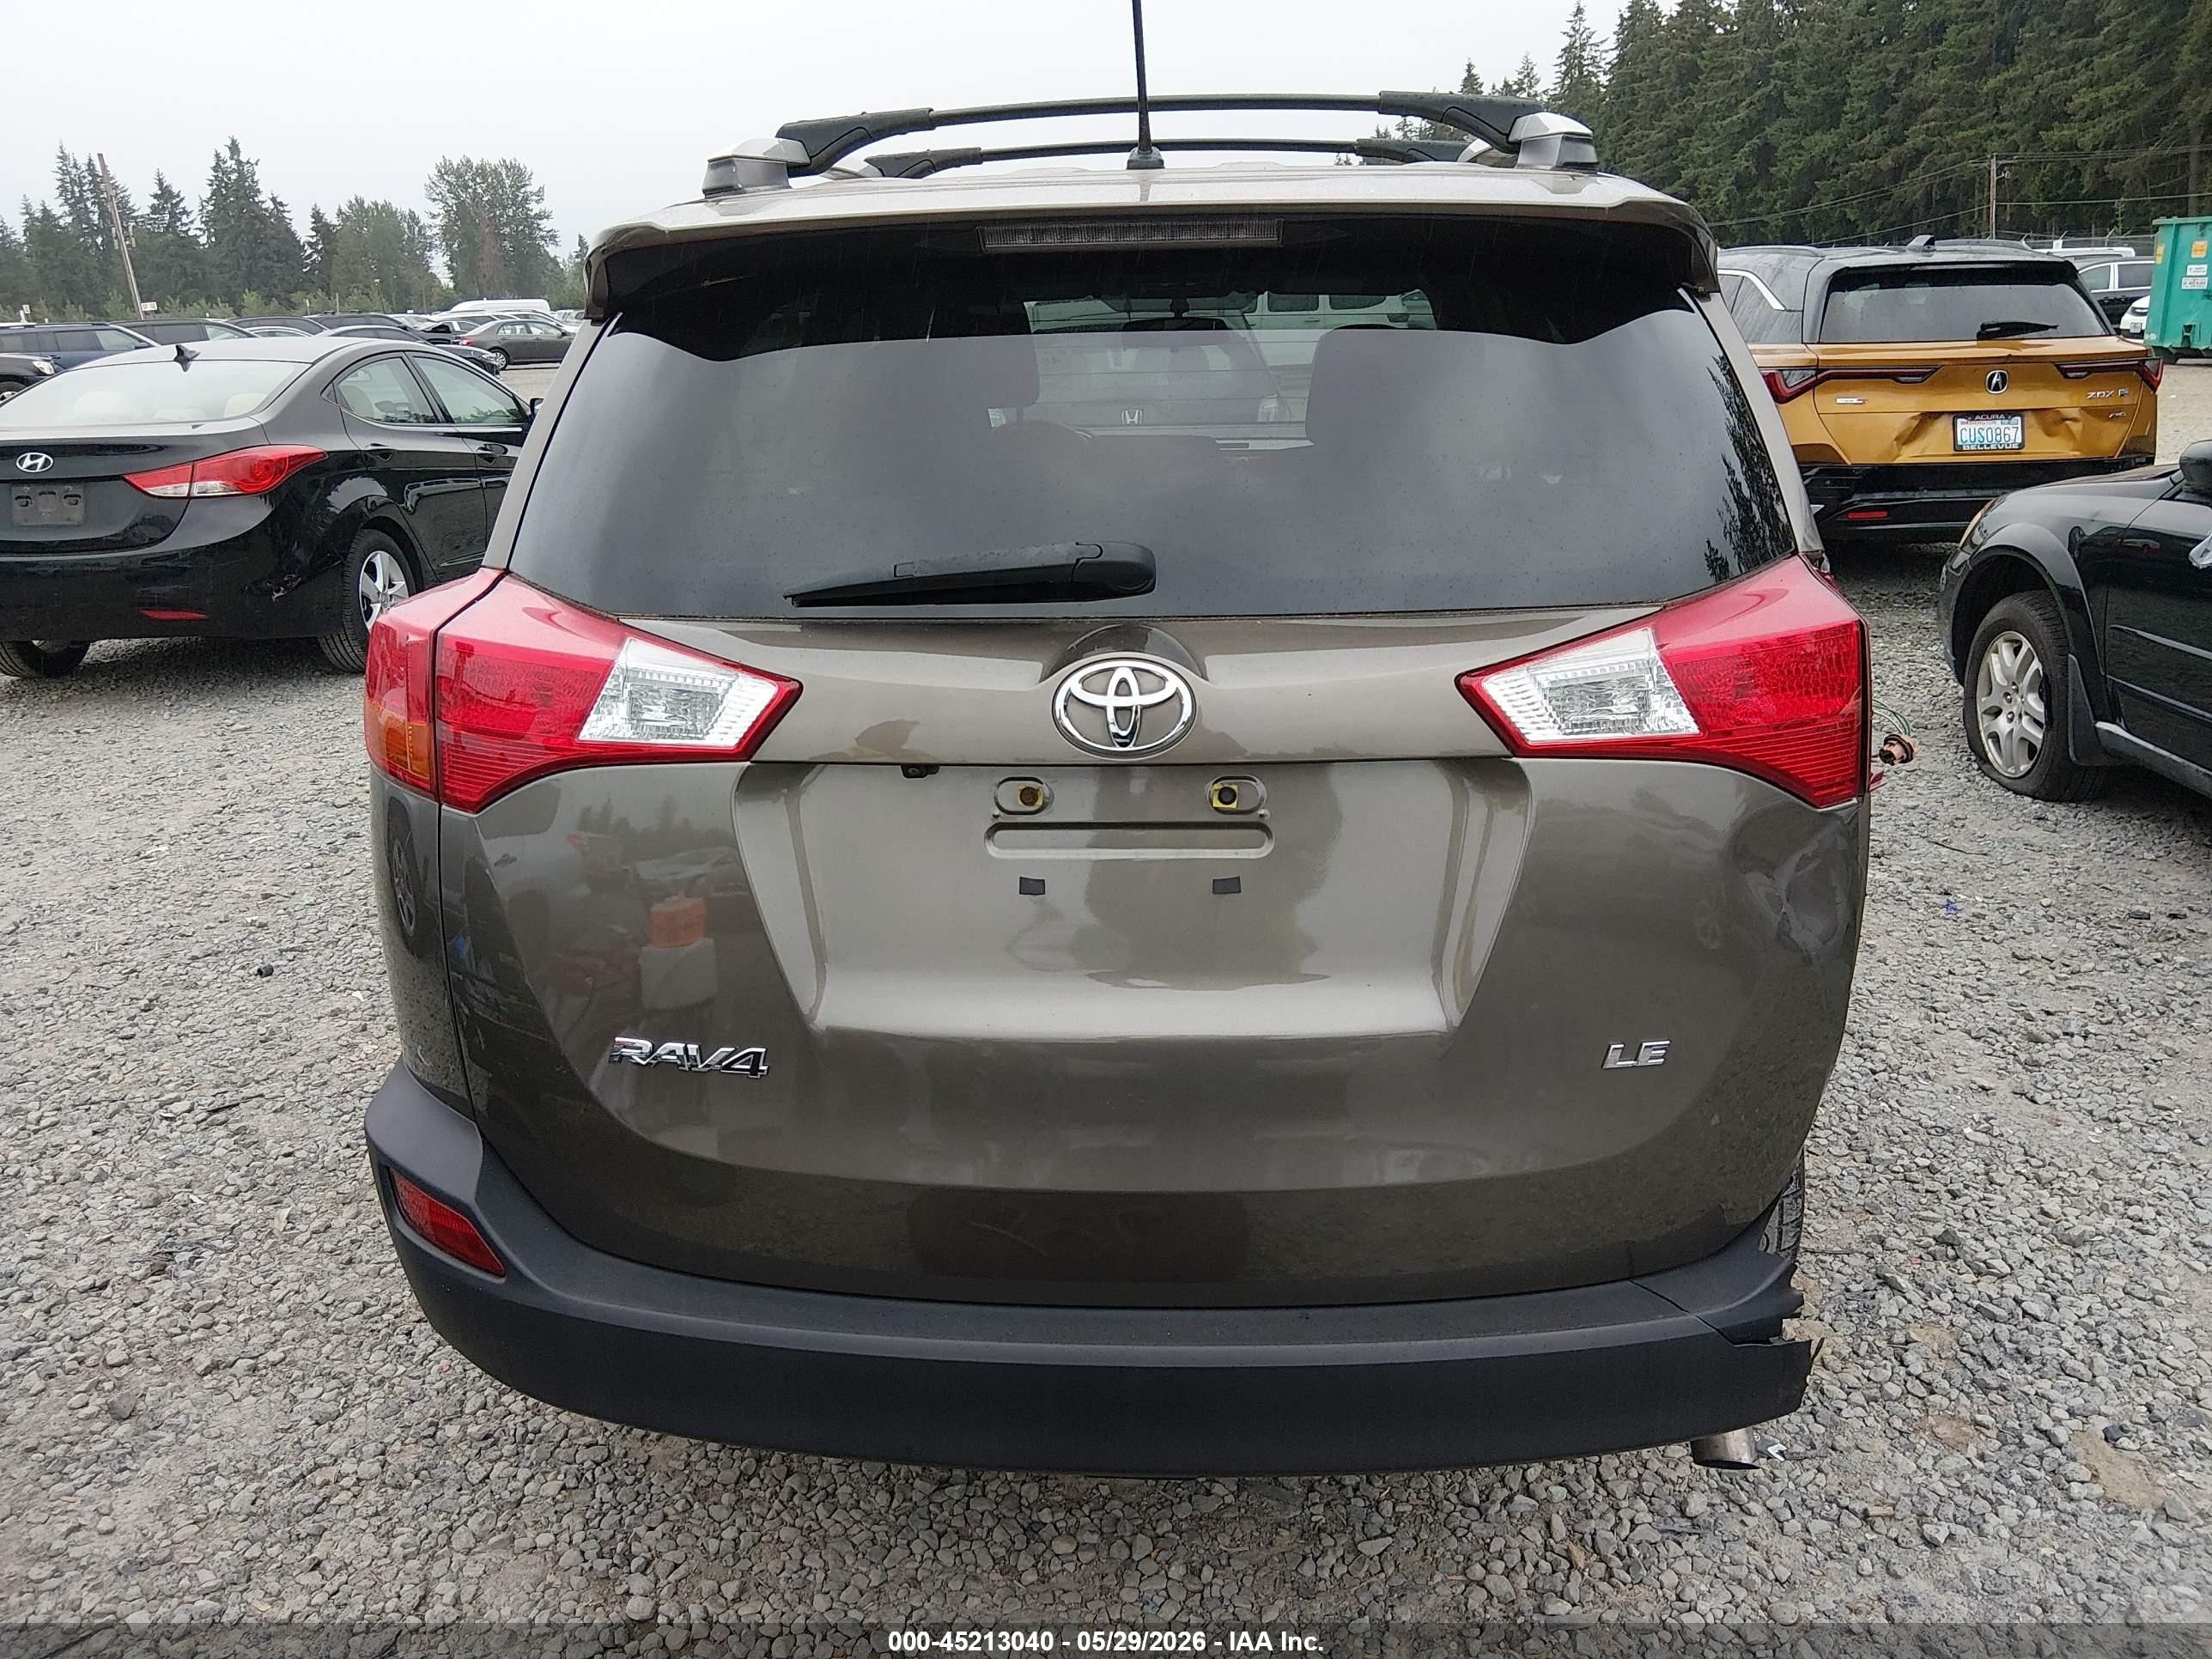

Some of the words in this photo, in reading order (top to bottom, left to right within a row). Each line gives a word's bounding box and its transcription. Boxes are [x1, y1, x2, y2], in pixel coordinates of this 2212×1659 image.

[2086, 390, 2115, 399] ZDX
[1960, 426, 2020, 444] CUS0867
[608, 1036, 769, 1079] RAV4
[1601, 1040, 1671, 1070] LE
